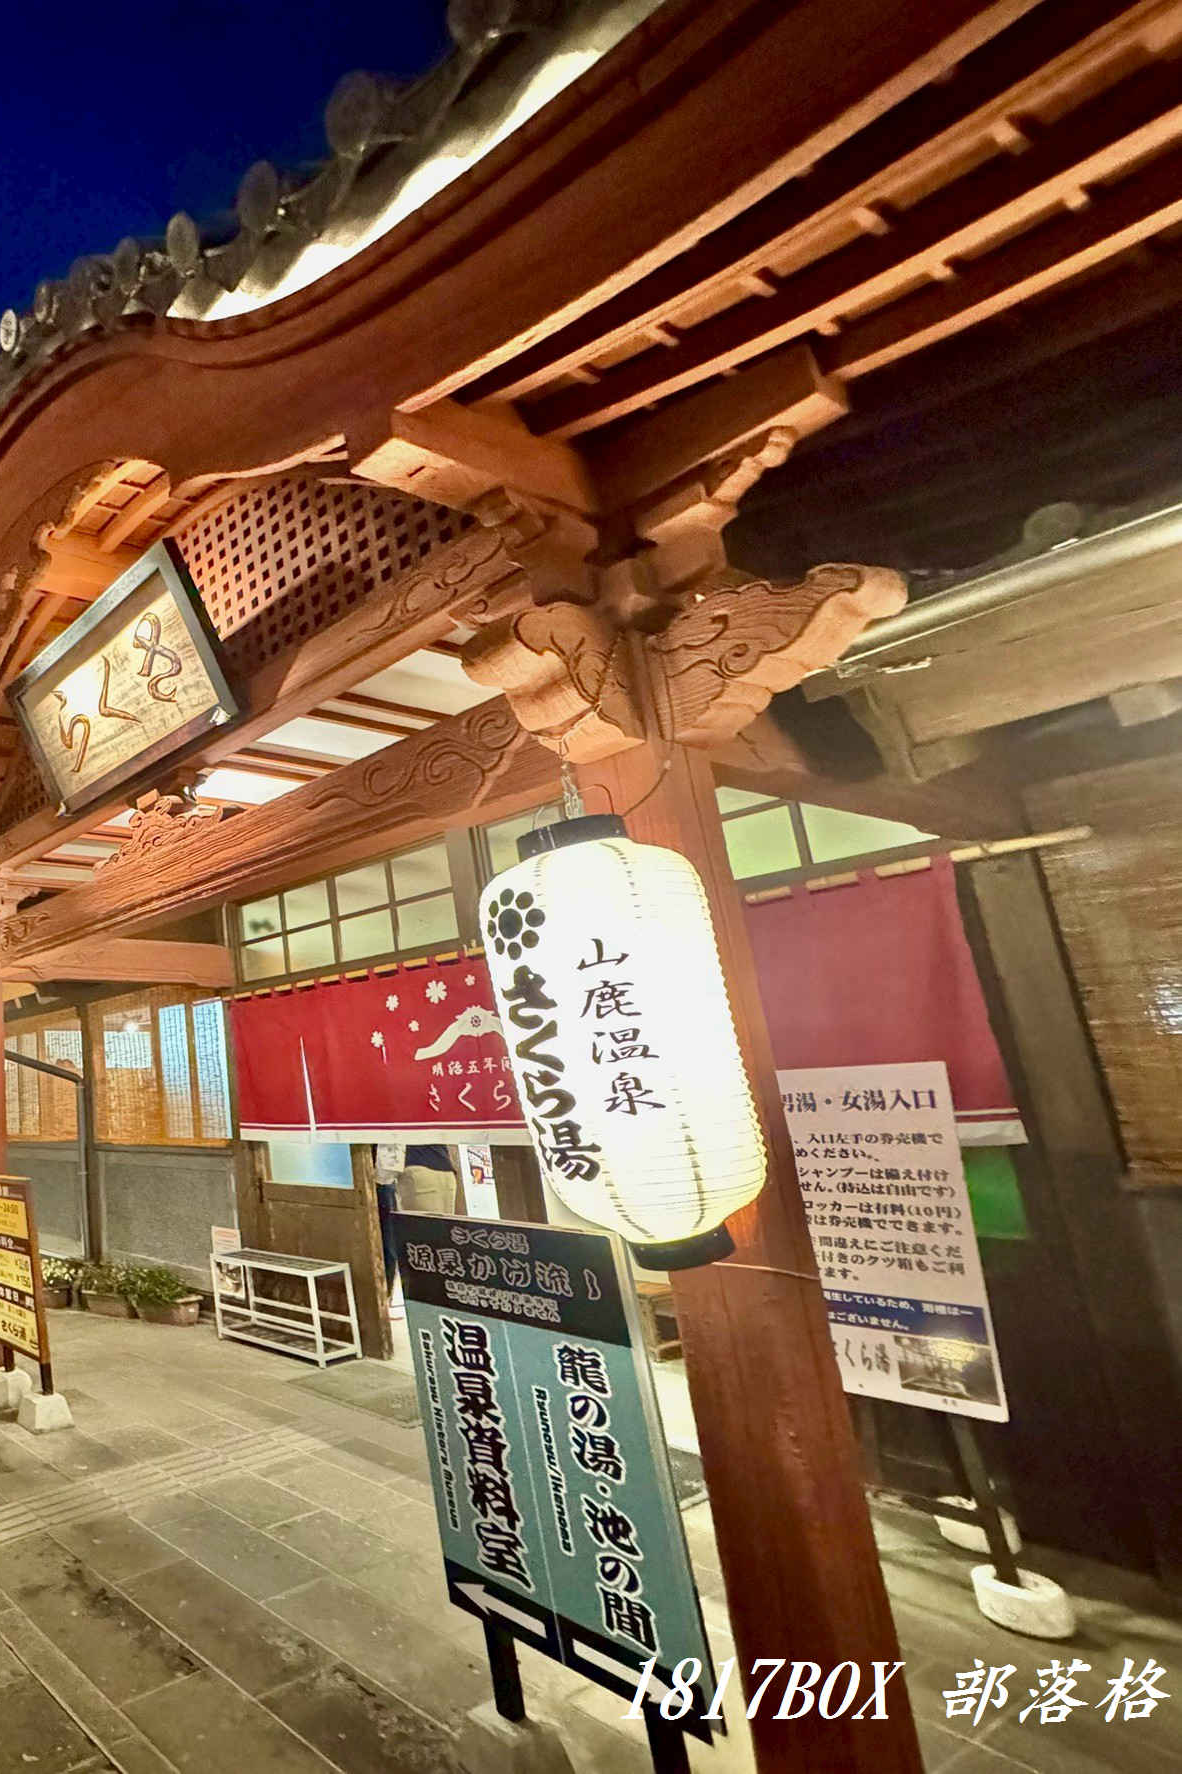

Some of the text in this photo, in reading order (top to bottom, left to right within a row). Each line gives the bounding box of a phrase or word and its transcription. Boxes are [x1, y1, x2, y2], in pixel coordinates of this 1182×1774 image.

[577, 938, 667, 1116] 山鹿温泉
[501, 965, 602, 1182] さくら湯
[428, 1079, 512, 1112] さくら
[450, 1226, 530, 1255] さくら湯
[812, 1235, 963, 1260] 間違えにご注意くだ
[817, 1250, 965, 1276] 付きのクツ箱もご利
[819, 1265, 859, 1281] ます。
